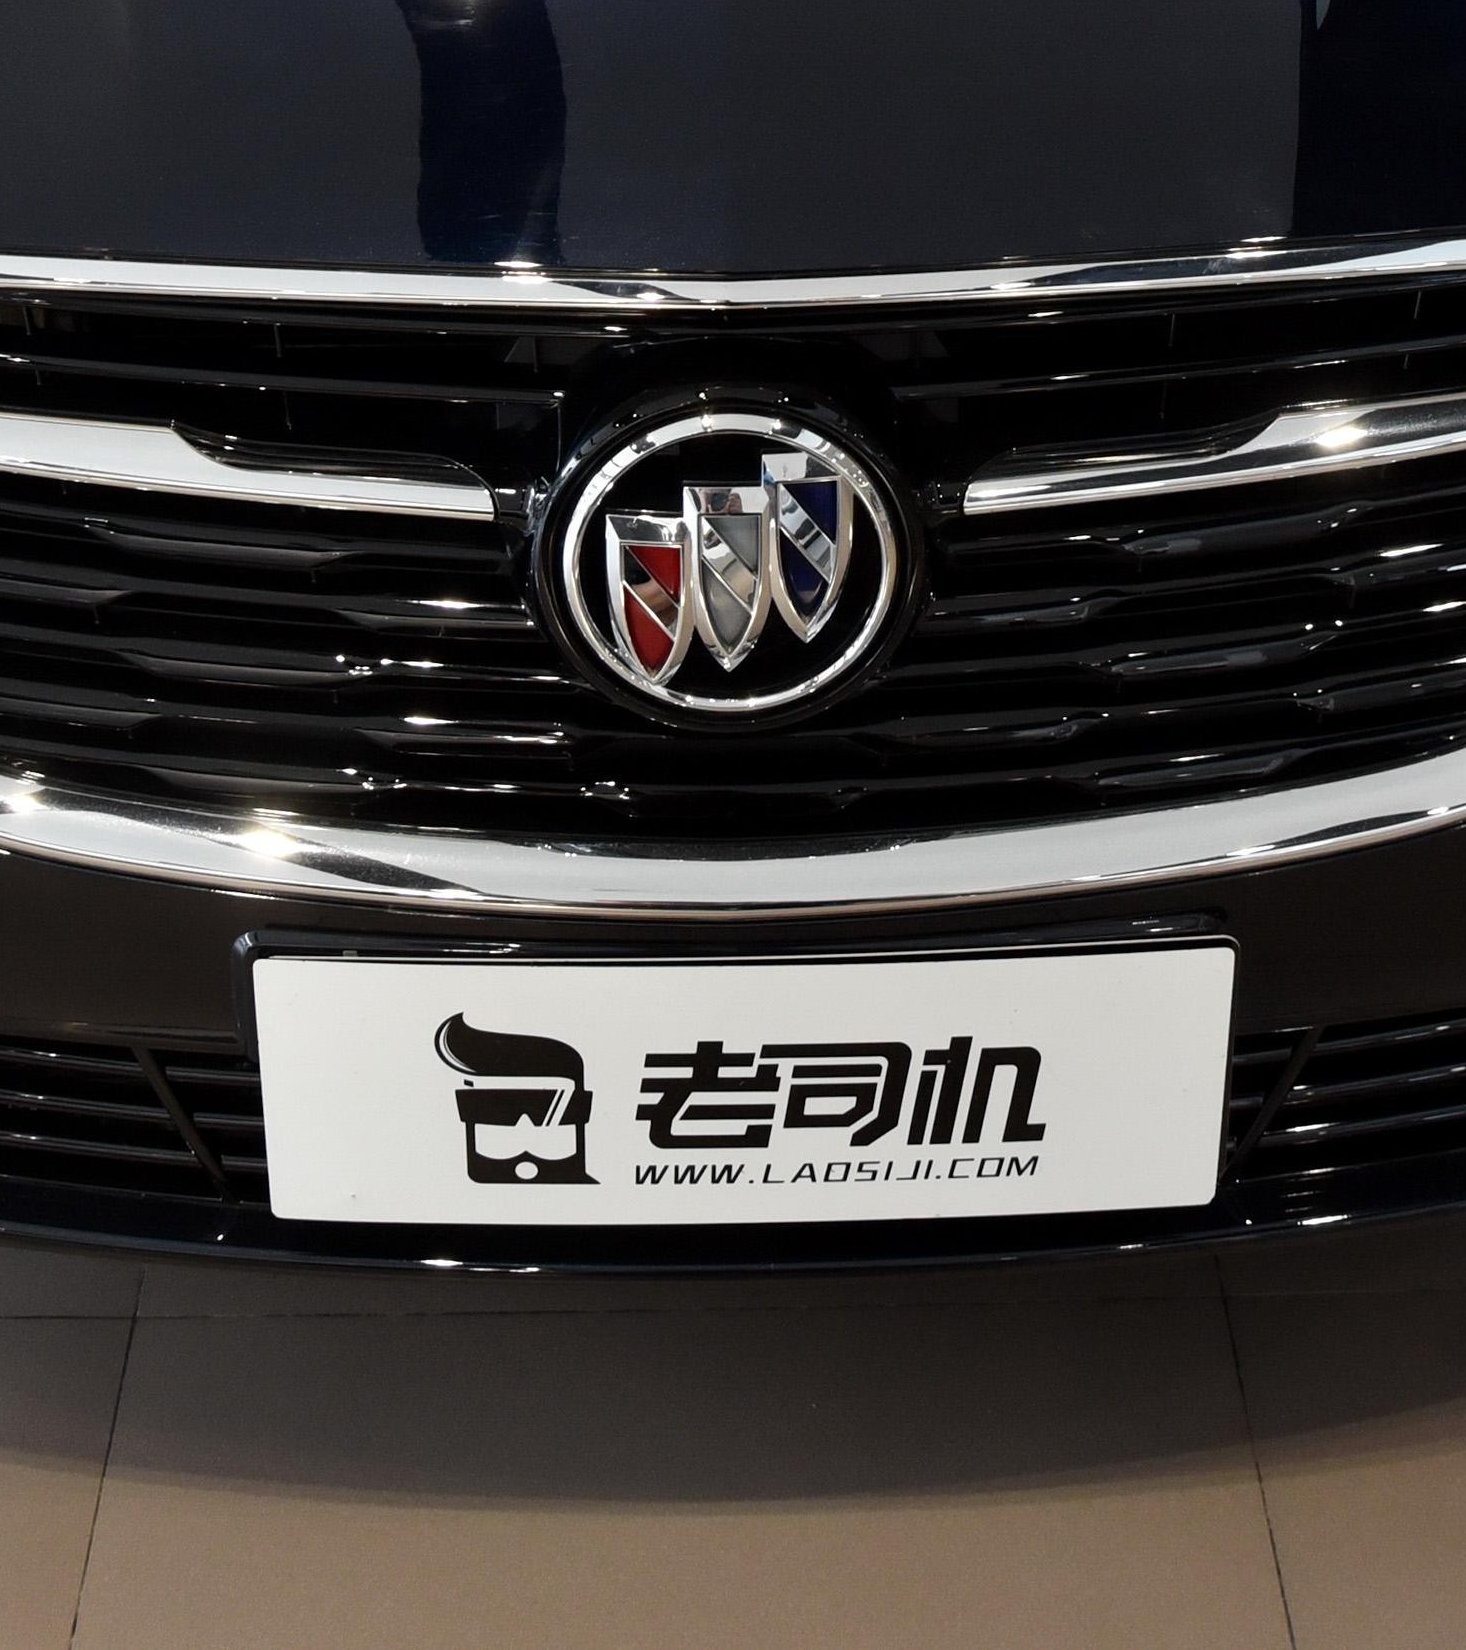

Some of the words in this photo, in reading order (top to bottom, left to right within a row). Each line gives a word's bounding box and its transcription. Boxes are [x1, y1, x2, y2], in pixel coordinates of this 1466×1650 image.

[635, 1035, 1048, 1151] 老司机
[634, 1155, 1040, 1186] WWW.LAOSIJI.COM
